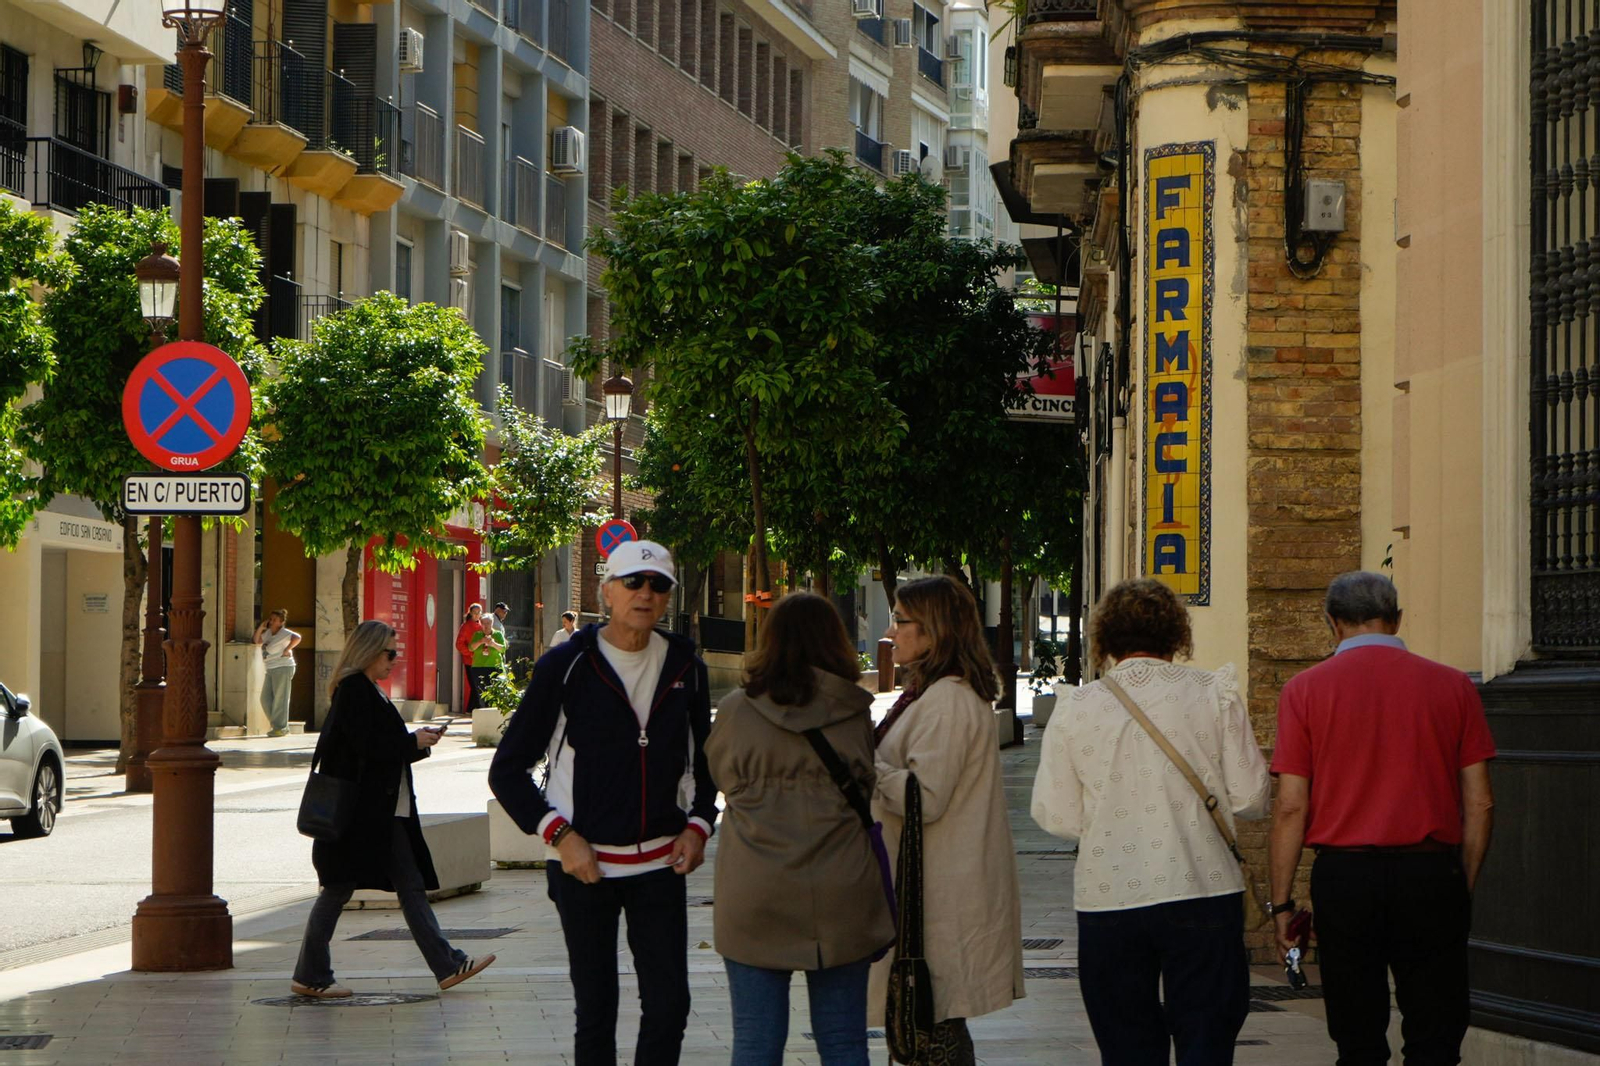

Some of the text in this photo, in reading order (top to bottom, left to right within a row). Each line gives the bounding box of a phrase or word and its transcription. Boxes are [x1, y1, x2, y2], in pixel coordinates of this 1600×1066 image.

[1153, 174, 1191, 574] FARMACIA
[170, 456, 199, 466] GRUA
[127, 482, 243, 503] EN C/ PUERTO
[60, 521, 112, 542] EDIFICIO SAN CASIANO
